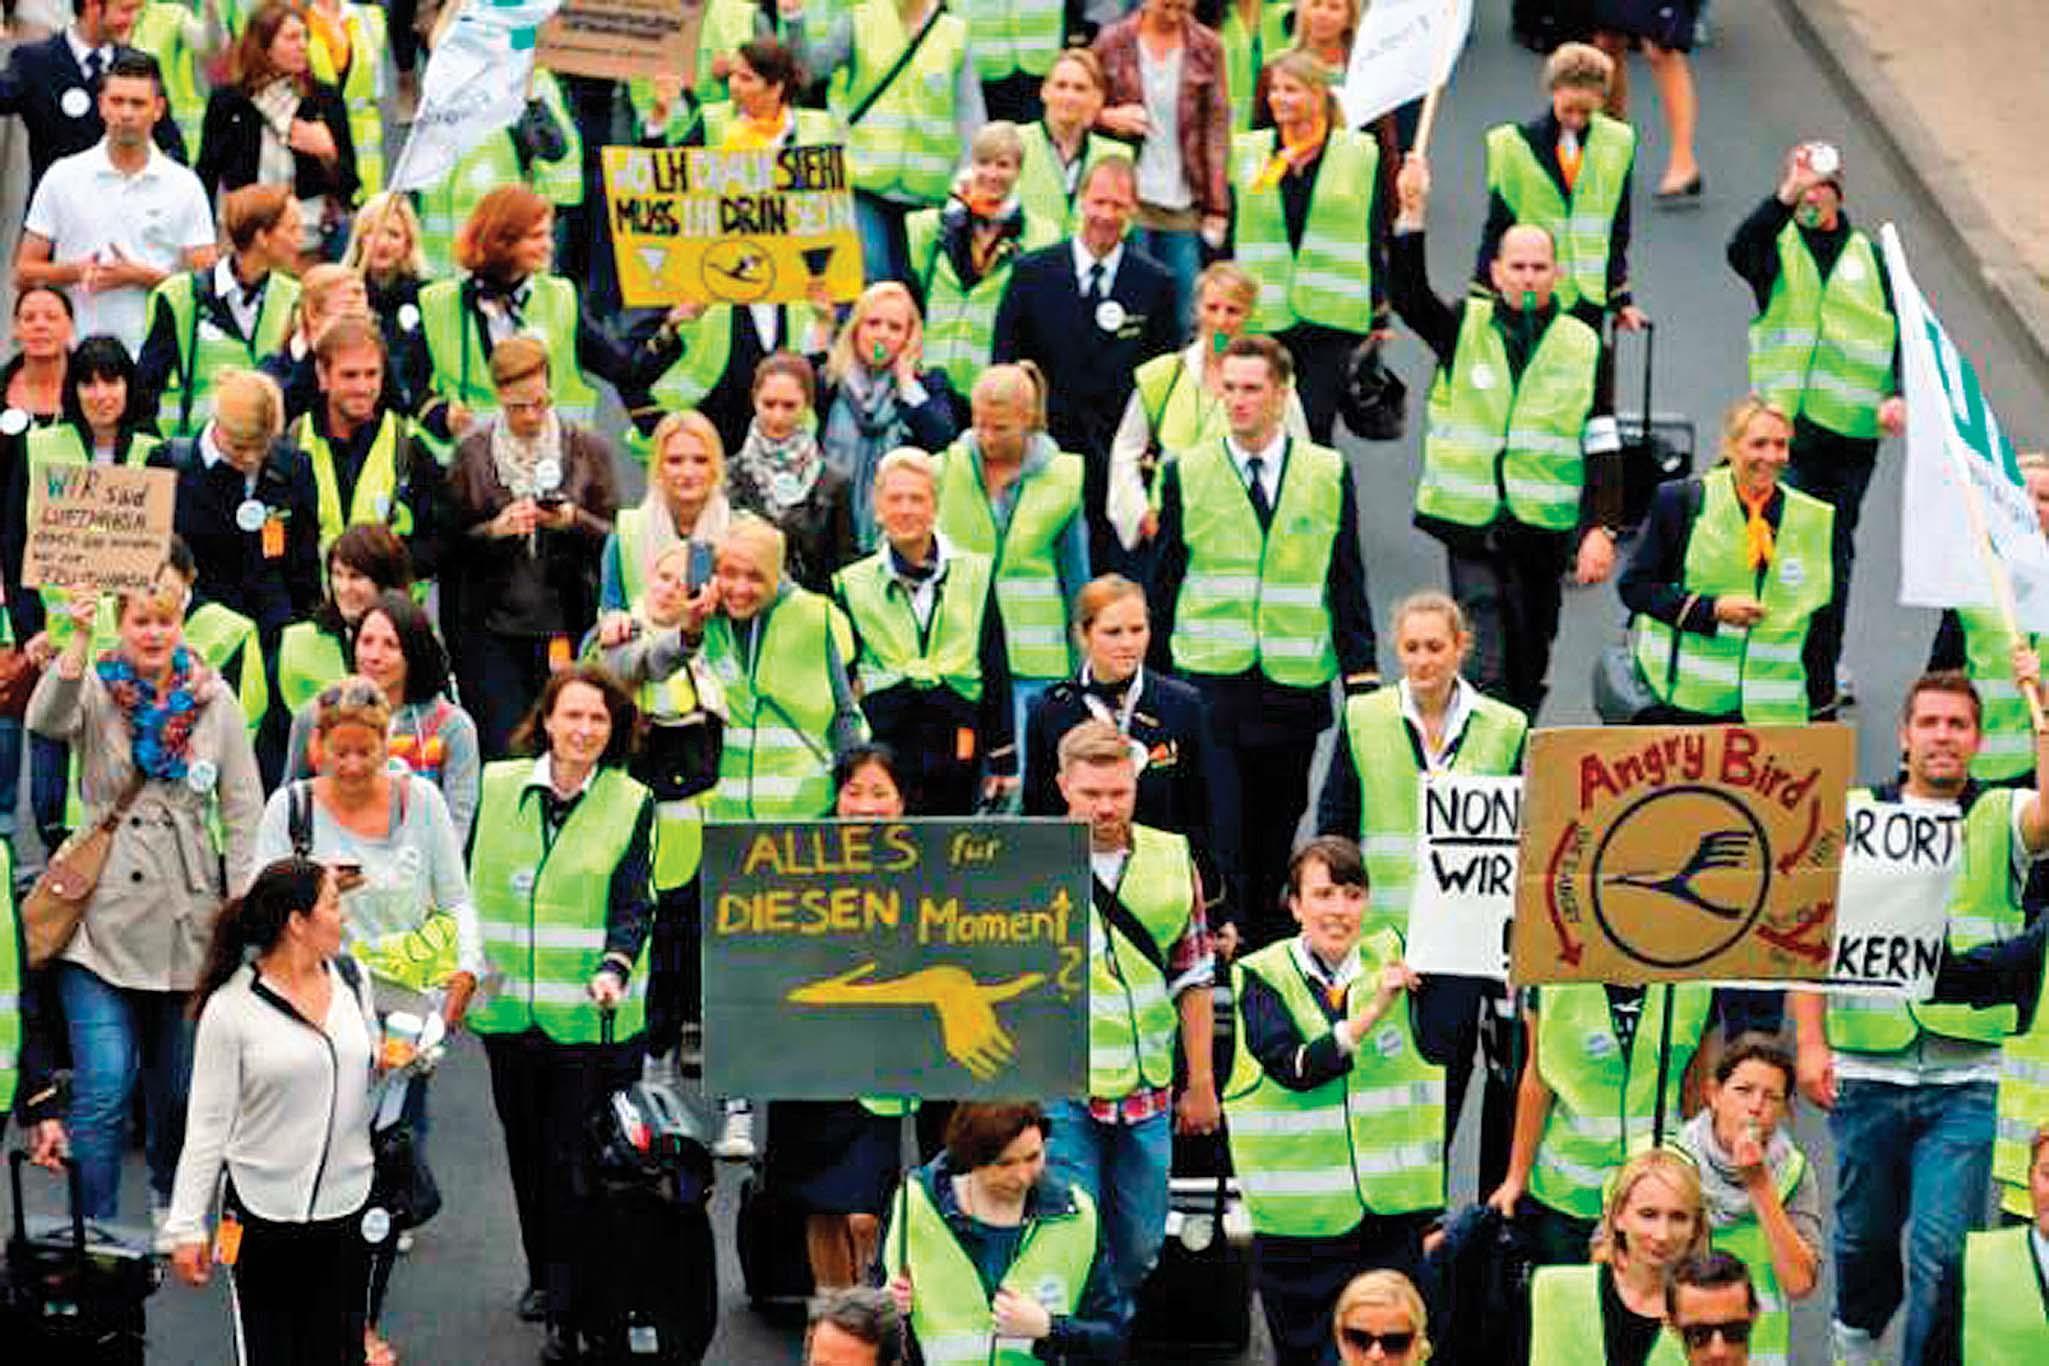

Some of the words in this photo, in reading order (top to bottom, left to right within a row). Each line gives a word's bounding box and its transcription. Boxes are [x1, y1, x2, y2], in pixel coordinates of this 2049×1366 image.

[616, 198, 680, 237] MUSS
[720, 195, 788, 236] DRIN
[47, 467, 99, 498] WIR
[1580, 733, 1705, 814] Angry
[1720, 728, 1822, 811] Bird
[1426, 786, 1520, 836] NON
[742, 825, 921, 875] ALLES
[1884, 812, 1962, 866] ORT
[1430, 850, 1512, 896] WIR
[716, 888, 899, 935] DIESEN
[917, 886, 1071, 946] Moment
[1834, 934, 1940, 981] KERN
